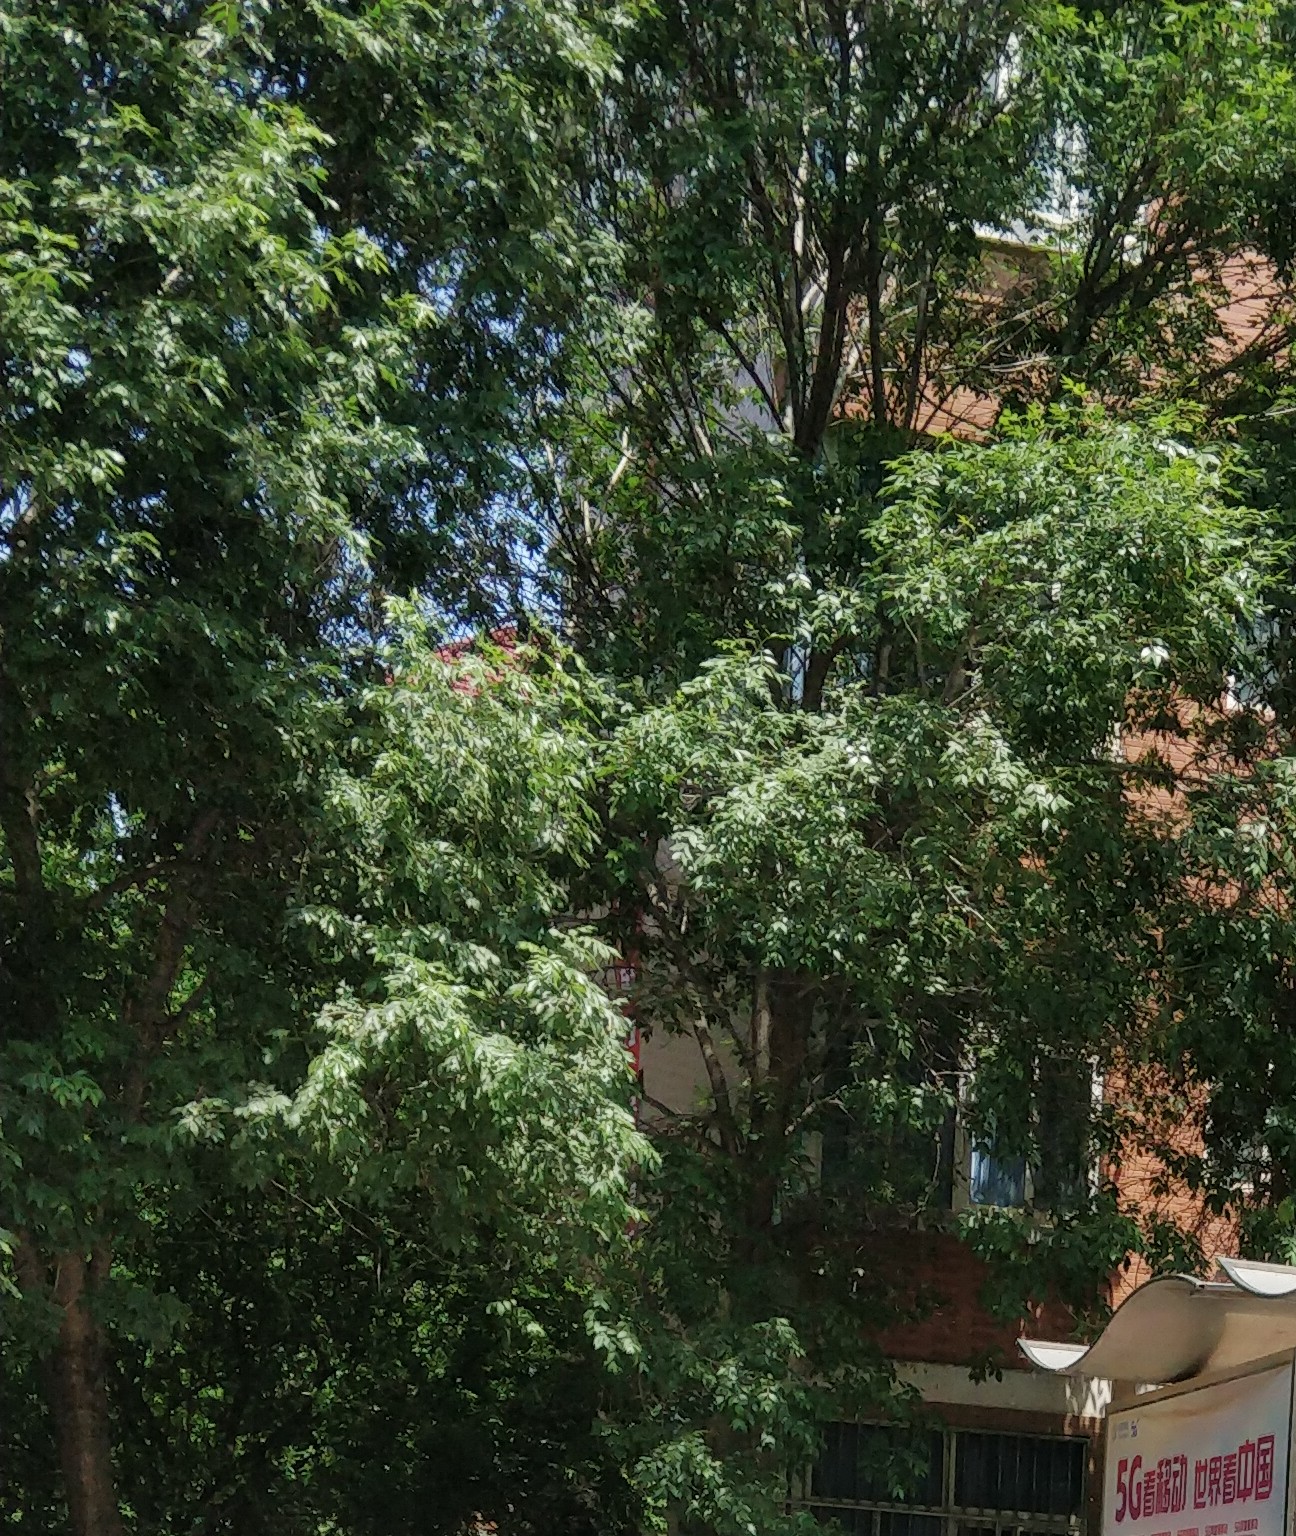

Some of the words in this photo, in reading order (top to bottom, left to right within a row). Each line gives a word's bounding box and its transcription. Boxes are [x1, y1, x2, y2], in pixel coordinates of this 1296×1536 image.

[1115, 1454, 1188, 1523] 5G看移动
[1194, 1434, 1275, 1510] 世界看中国
